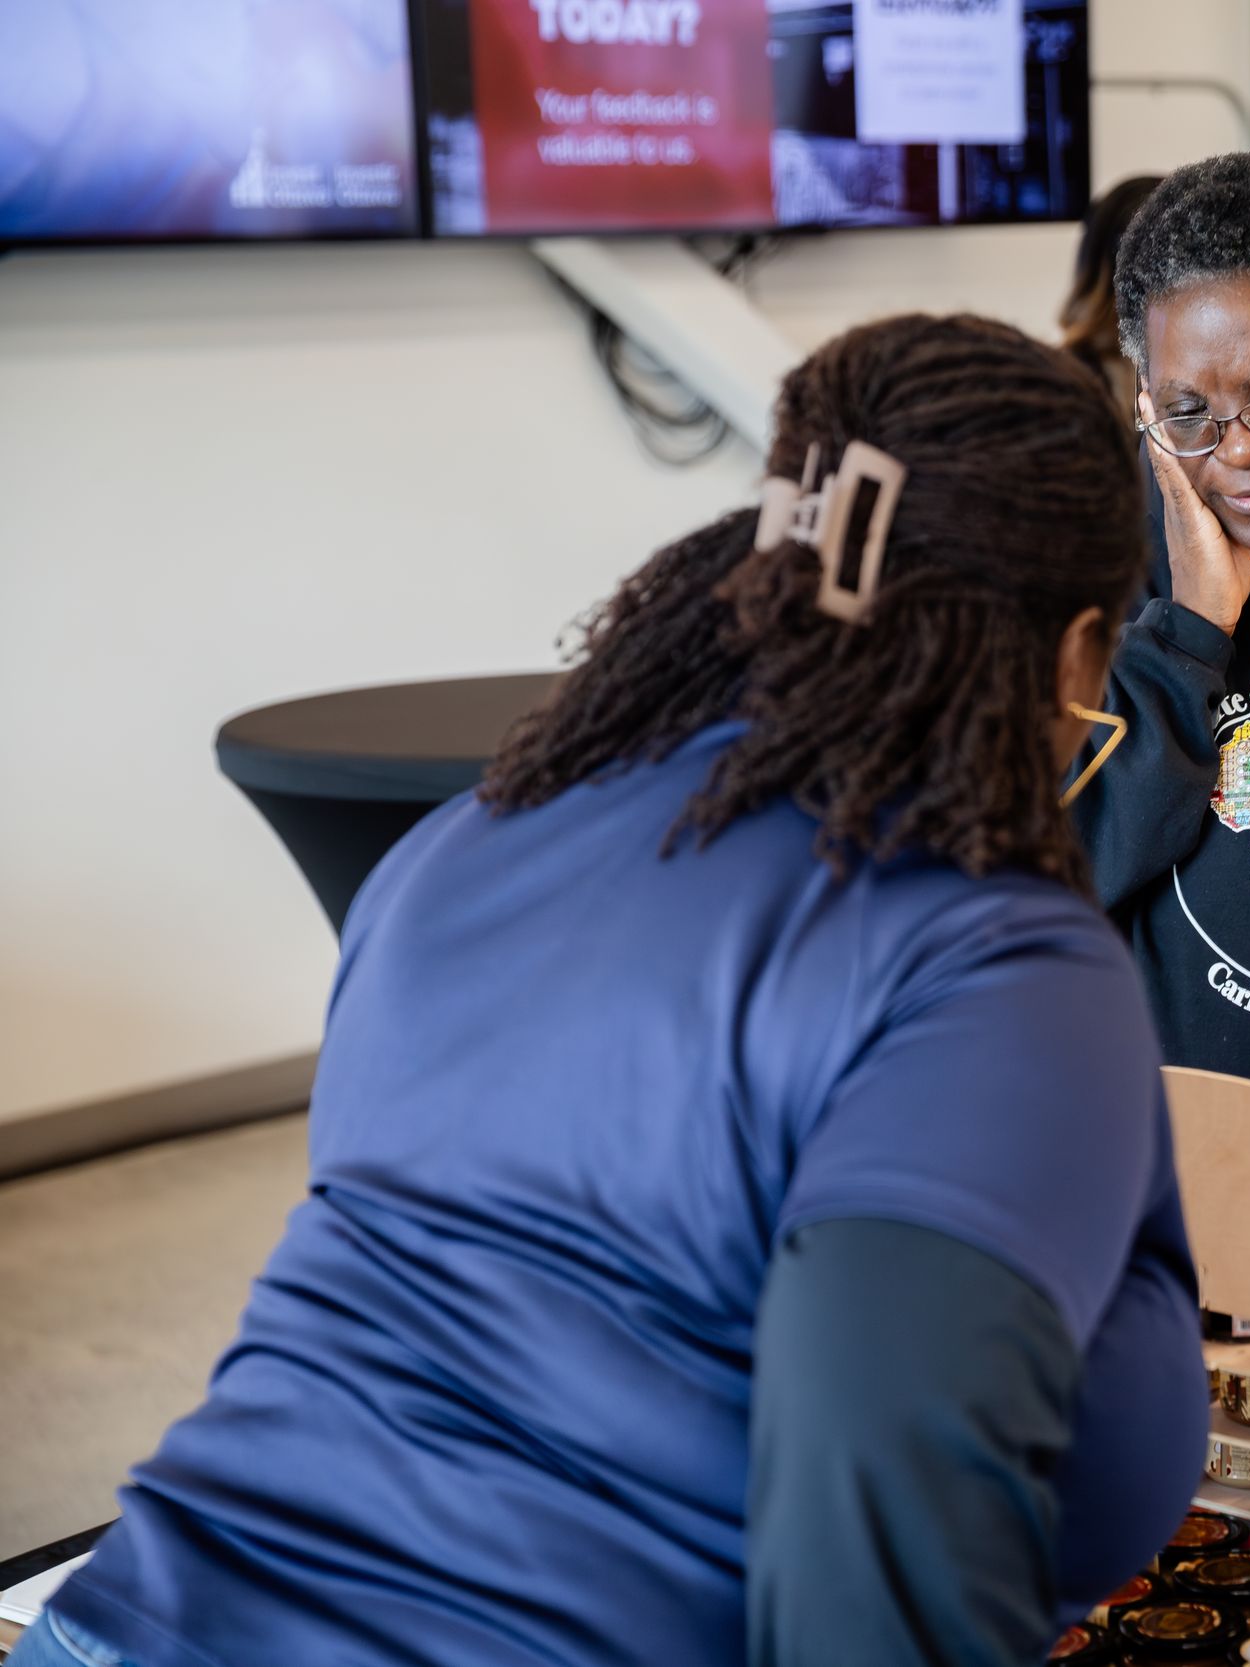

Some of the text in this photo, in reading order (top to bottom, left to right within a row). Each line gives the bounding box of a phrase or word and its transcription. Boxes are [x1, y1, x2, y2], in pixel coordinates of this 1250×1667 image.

[530, 0, 702, 48] TODAY?
[535, 88, 590, 125] Your
[591, 88, 690, 125] feedback
